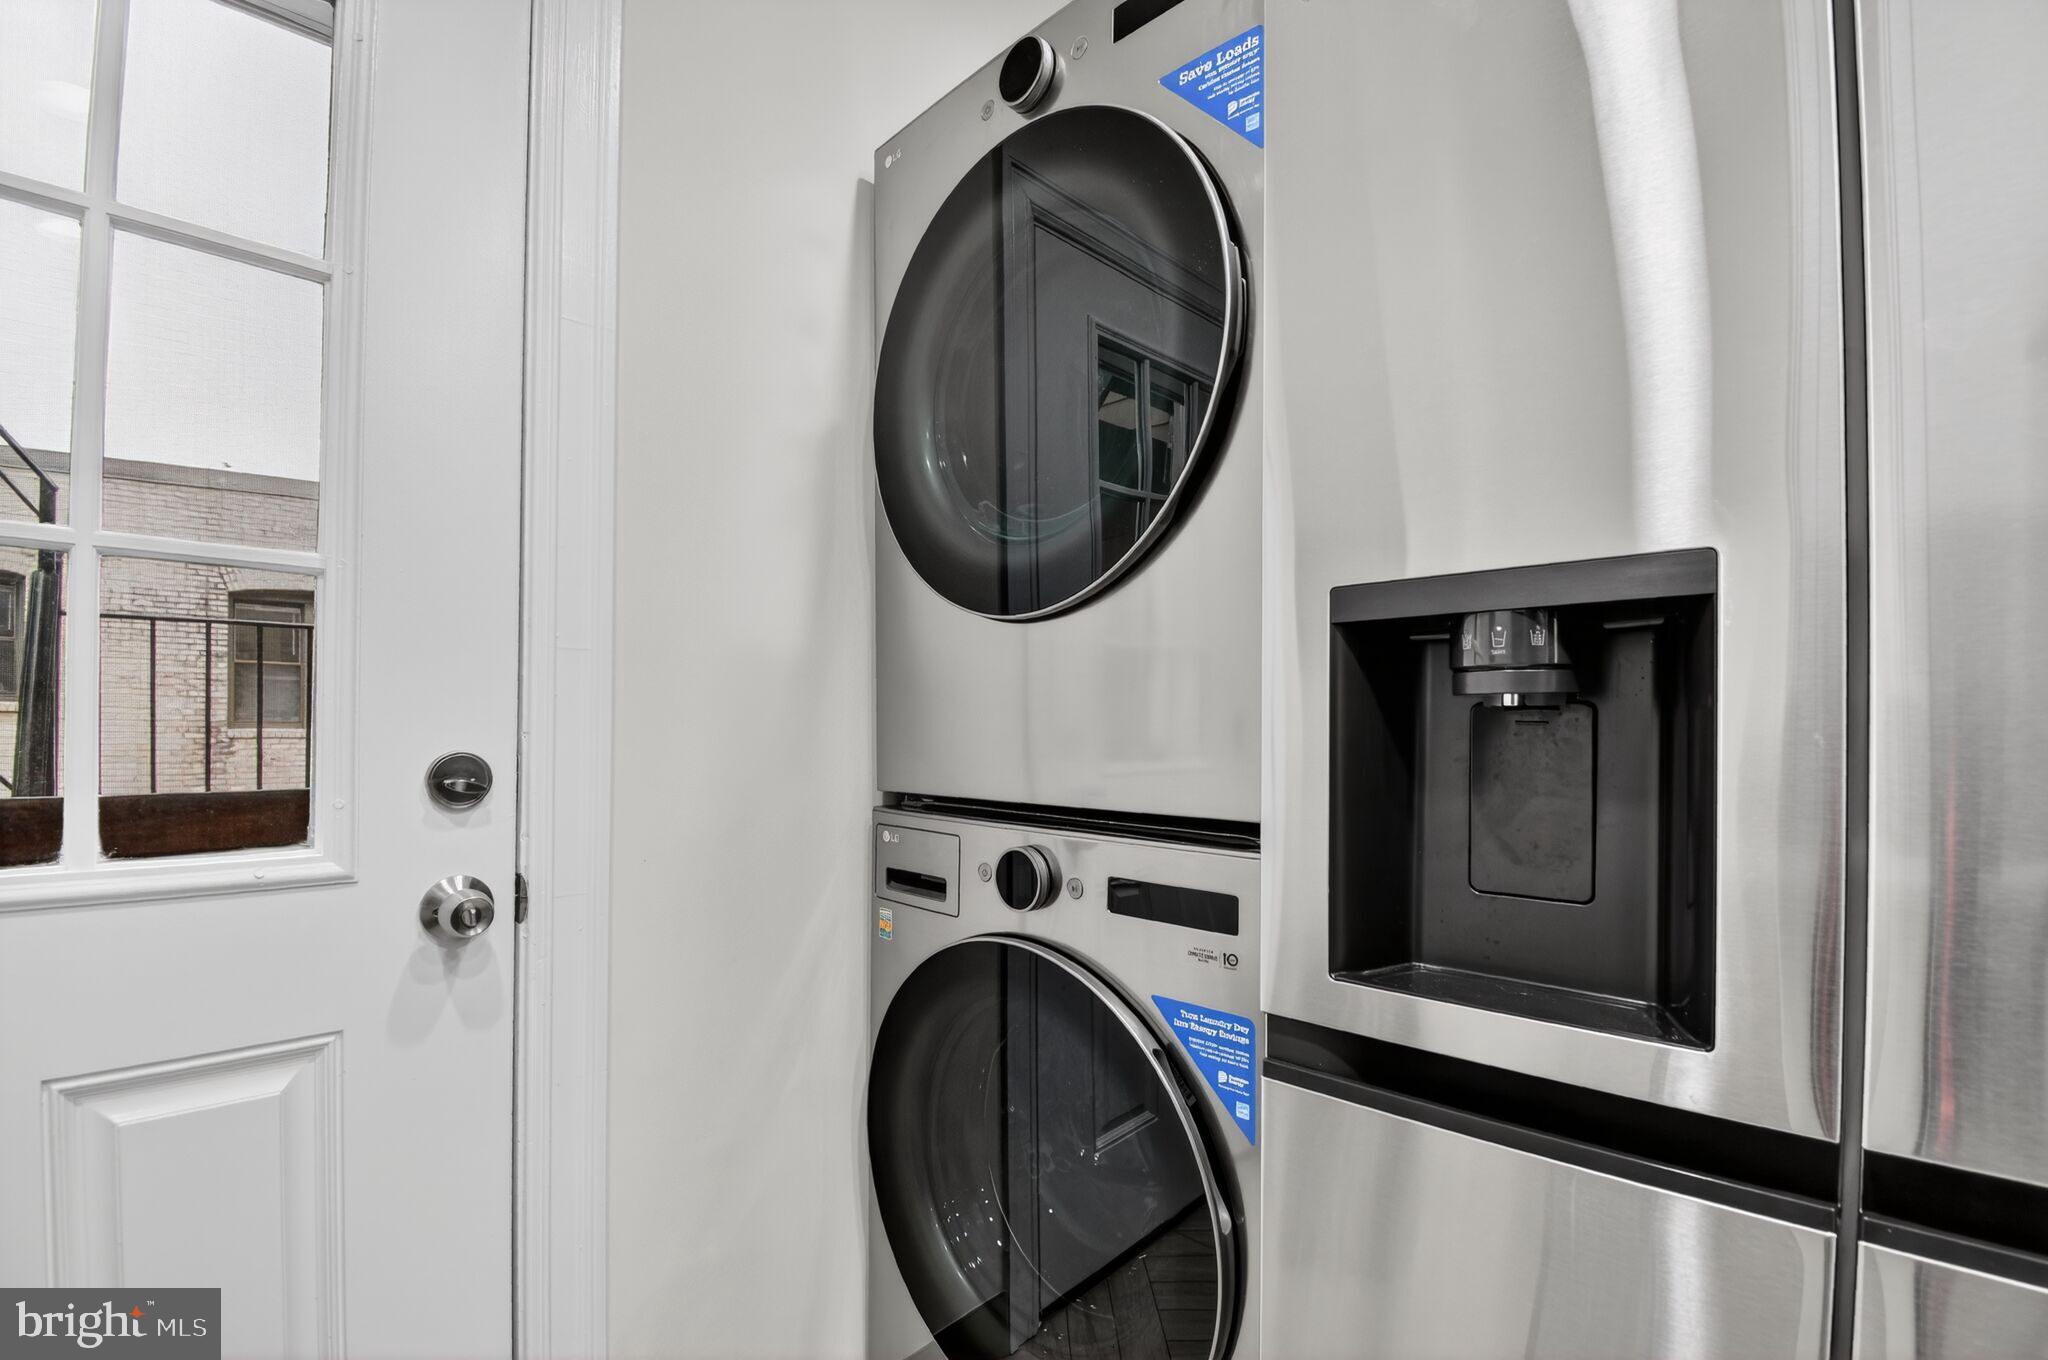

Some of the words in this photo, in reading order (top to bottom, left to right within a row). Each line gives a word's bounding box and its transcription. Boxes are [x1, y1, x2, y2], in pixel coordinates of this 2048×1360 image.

[1179, 60, 1212, 86] Save
[1216, 36, 1259, 65] Loads
[1200, 1014, 1233, 1031] Laundry
[1234, 1022, 1249, 1035] Day
